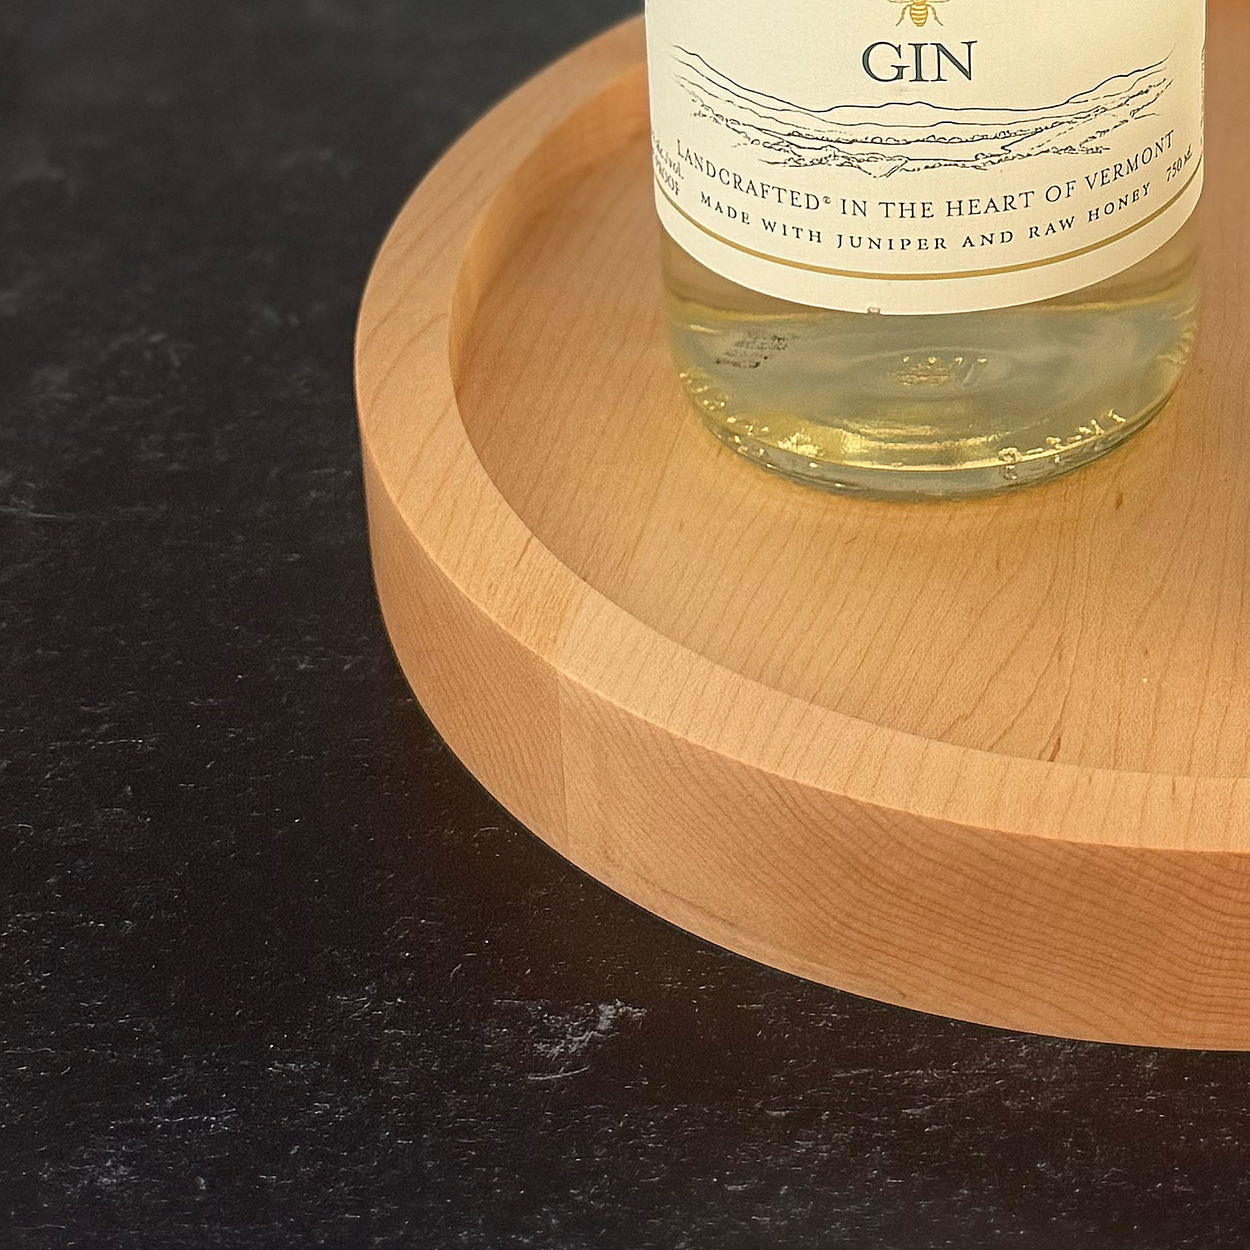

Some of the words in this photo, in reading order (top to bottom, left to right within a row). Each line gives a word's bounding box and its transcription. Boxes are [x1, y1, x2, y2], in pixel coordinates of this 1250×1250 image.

[861, 40, 978, 84] GIN
[841, 198, 868, 218] IN
[878, 201, 935, 219] THE
[946, 190, 1035, 218] HEART
[1045, 180, 1077, 203] OF
[1085, 129, 1175, 190] VERMONT
[1166, 156, 1183, 182] 750
[701, 191, 750, 225] MADE
[761, 218, 822, 244] WITH
[837, 234, 947, 251] JUNIPER
[962, 230, 1014, 248] AND
[1028, 216, 1075, 239] RAW
[1088, 182, 1151, 223] HONEY
